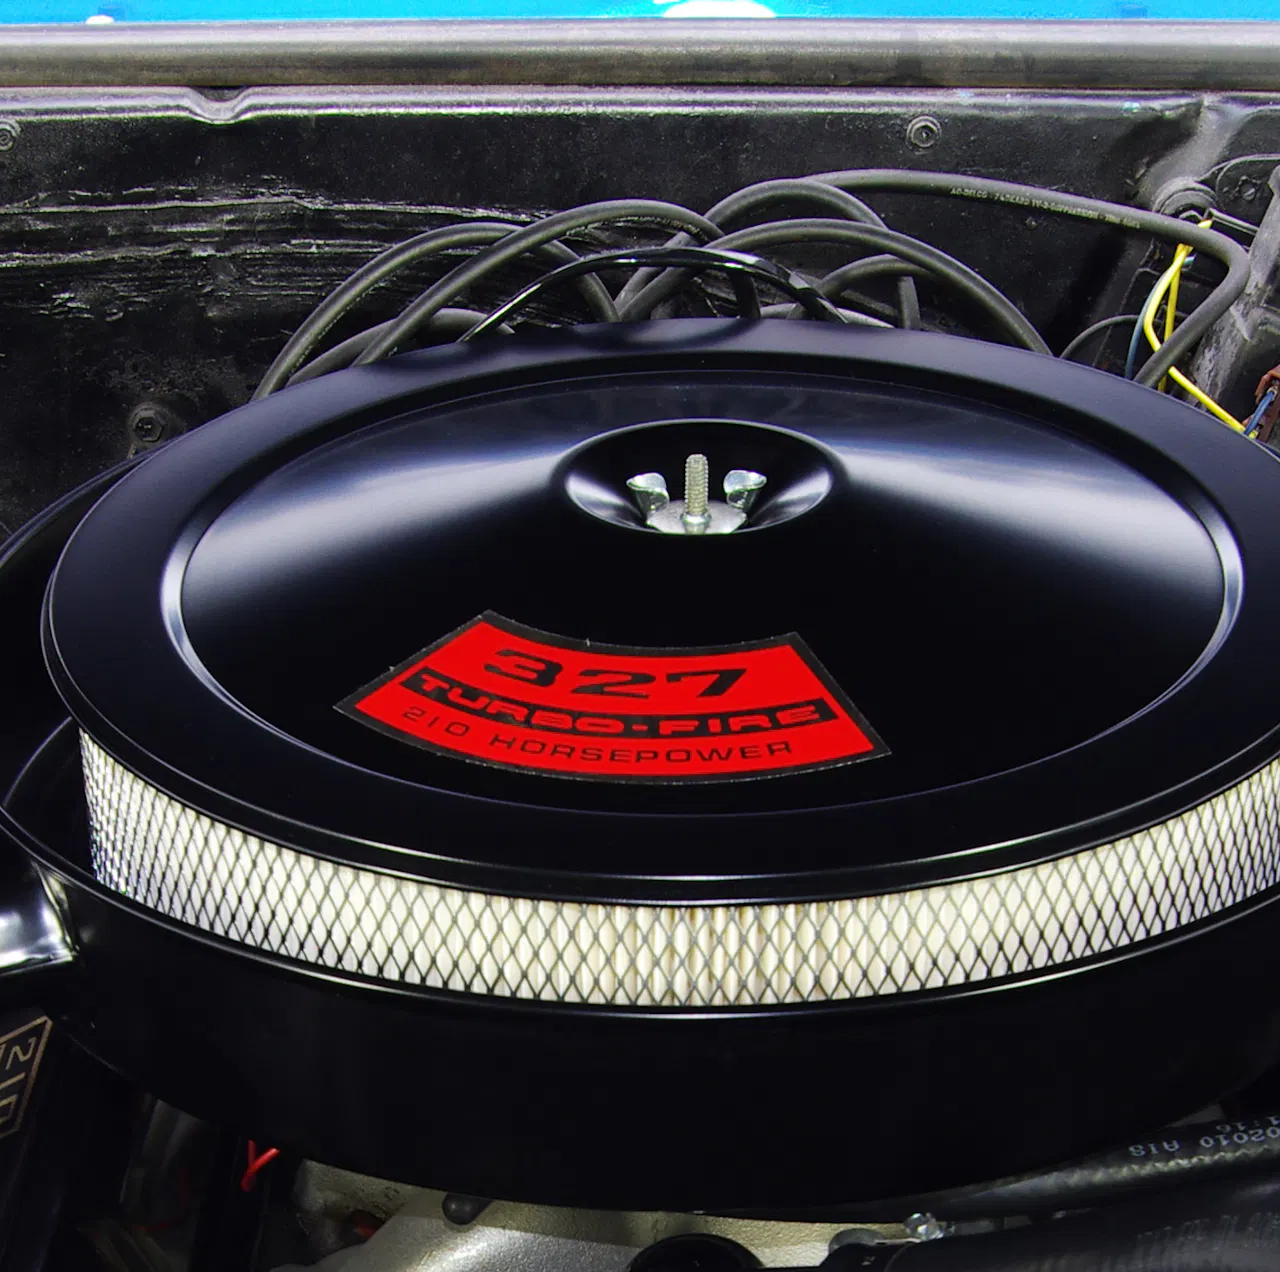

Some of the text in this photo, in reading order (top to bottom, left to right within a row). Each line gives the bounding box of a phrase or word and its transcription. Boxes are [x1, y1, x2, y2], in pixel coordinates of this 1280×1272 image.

[484, 648, 747, 699] 327
[420, 672, 820, 736] TURBO-FIRE
[401, 706, 793, 763] 210 HORSEPOWER
